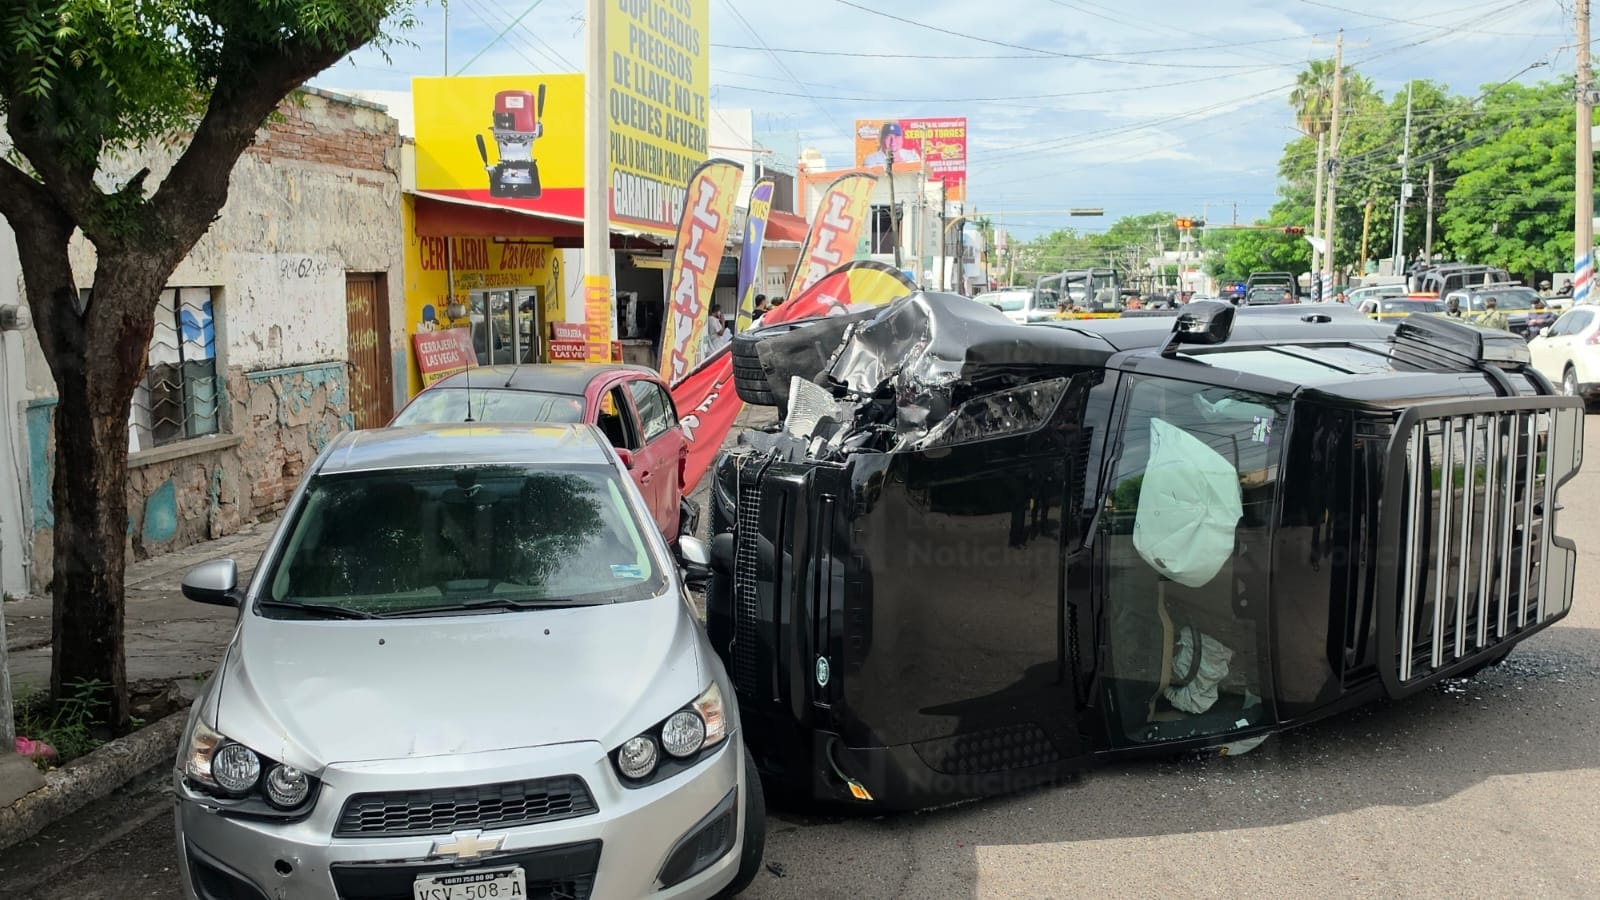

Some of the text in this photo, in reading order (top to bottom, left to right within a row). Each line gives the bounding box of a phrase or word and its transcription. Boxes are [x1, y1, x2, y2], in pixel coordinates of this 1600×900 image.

[629, 21, 692, 85] PRECISOS
[613, 50, 705, 123] DE LLAVE NO TE
[609, 87, 708, 155] QUEDES AFUERA
[610, 130, 627, 167] PILA
[635, 139, 663, 178] BATERIA
[664, 150, 681, 183] PARA
[613, 167, 663, 224] GARANTIA
[663, 181, 671, 224] Y
[426, 351, 460, 367] LAS VEGAS
